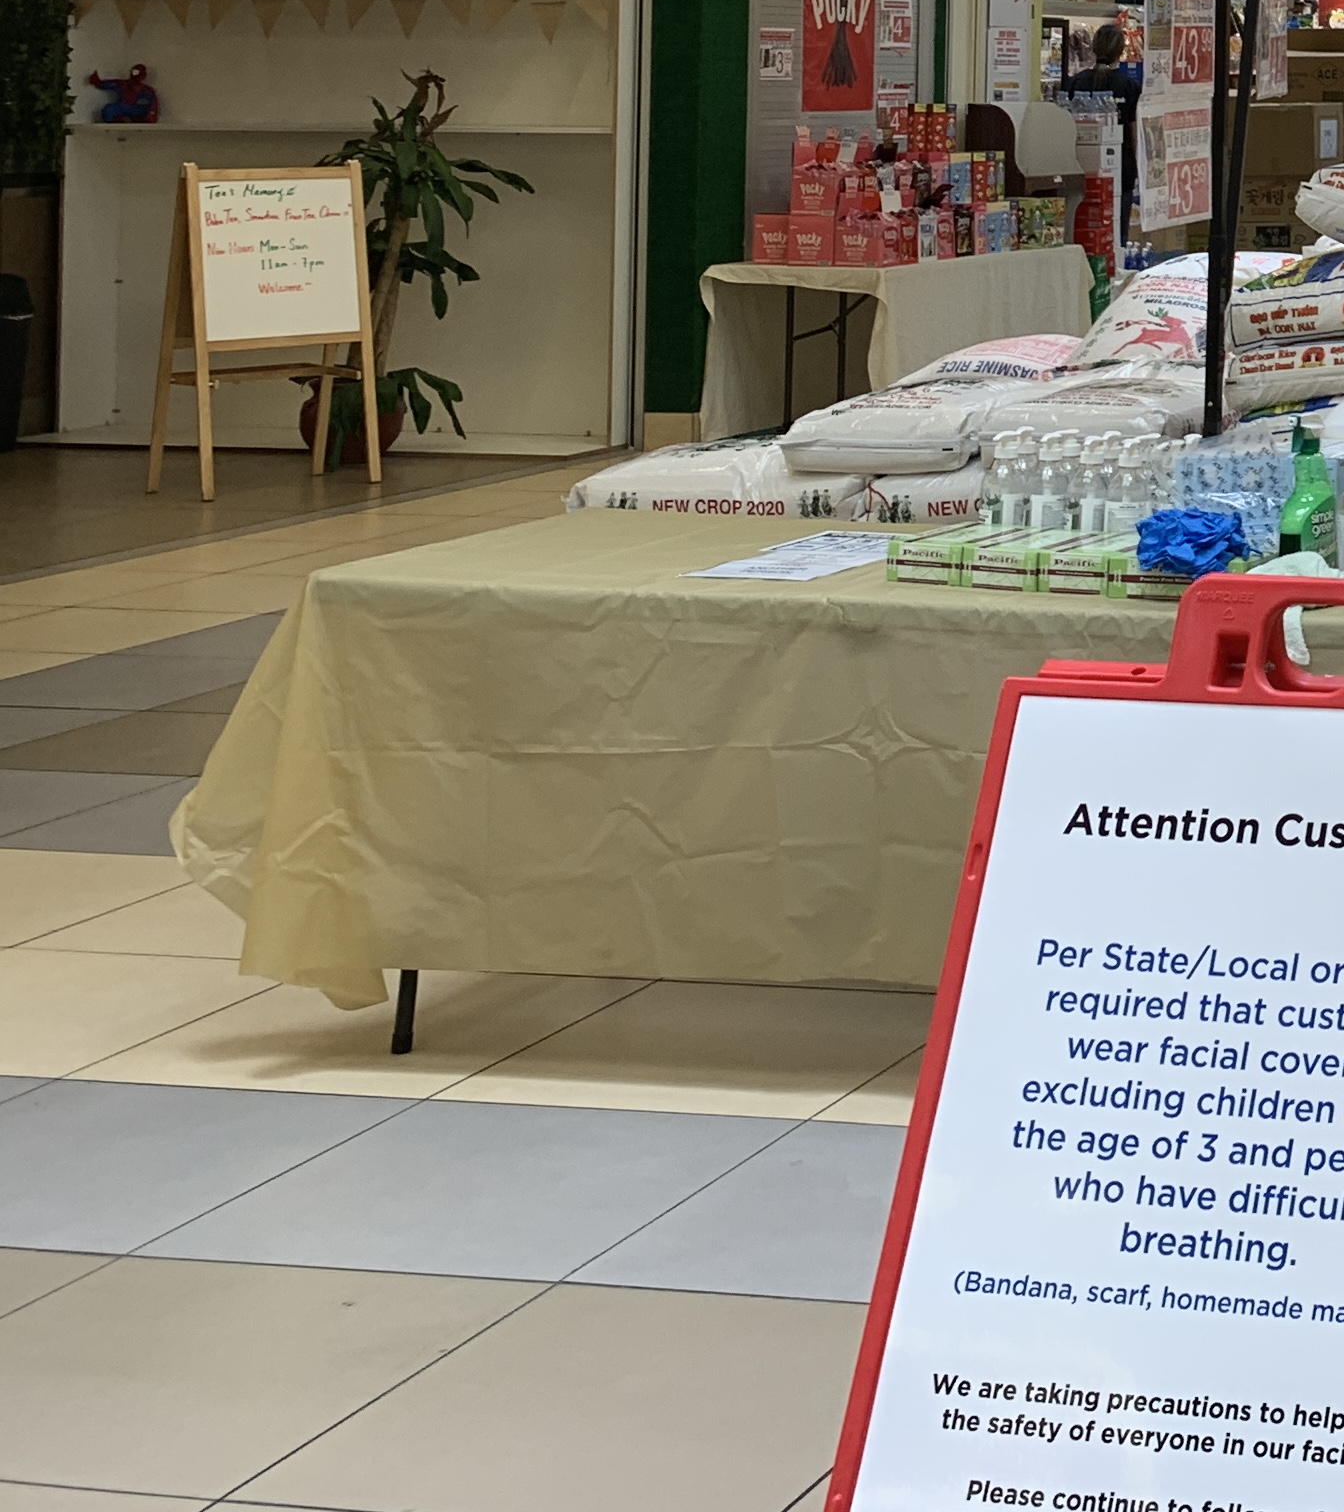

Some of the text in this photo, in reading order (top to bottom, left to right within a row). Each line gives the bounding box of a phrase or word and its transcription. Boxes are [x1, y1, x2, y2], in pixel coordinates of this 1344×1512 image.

[1175, 28, 1199, 81] 43
[1317, 68, 1338, 80] ACE
[1169, 165, 1193, 216] 43
[936, 359, 1039, 379] JASMINE RICE
[652, 499, 785, 516] NEW CROP 2020
[927, 501, 972, 517] NEW
[1310, 510, 1334, 525] simple
[1311, 522, 1334, 538] green
[902, 547, 945, 559] Pacific
[977, 553, 1020, 566] Pacific
[1053, 558, 1097, 569] Pacific
[1063, 804, 1259, 844] Attention
[1037, 939, 1093, 968] Per
[1103, 943, 1299, 981] State/Local
[1046, 988, 1188, 1020] required
[1200, 994, 1266, 1025] that
[1069, 1038, 1149, 1063] wear
[1160, 1036, 1249, 1070] facial
[1023, 1077, 1185, 1118] excluding
[1197, 1087, 1334, 1123] children
[1013, 1120, 1065, 1151] the
[1077, 1132, 1139, 1160] age
[1152, 1131, 1189, 1159] of
[1197, 1133, 1218, 1162] 3
[1229, 1139, 1294, 1168] and
[1055, 1171, 1123, 1203] who
[1136, 1175, 1216, 1210] have
[1120, 1222, 1296, 1270] breathing.
[954, 1271, 1077, 1304] (Bandana,
[1087, 1284, 1151, 1310] scarf,
[1162, 1286, 1302, 1319] homemade
[934, 1374, 971, 1396] We
[979, 1383, 1016, 1400] are
[1026, 1382, 1100, 1411] taking
[1107, 1394, 1251, 1421] precautions
[1260, 1403, 1284, 1424] to
[943, 1409, 980, 1431] the
[988, 1414, 1062, 1443] safety
[1069, 1421, 1096, 1441] of
[1102, 1428, 1214, 1452] everyone
[1223, 1433, 1244, 1455] in
[1253, 1441, 1295, 1460] our
[967, 1480, 1044, 1507] Please
[1053, 1492, 1158, 1512] continue
